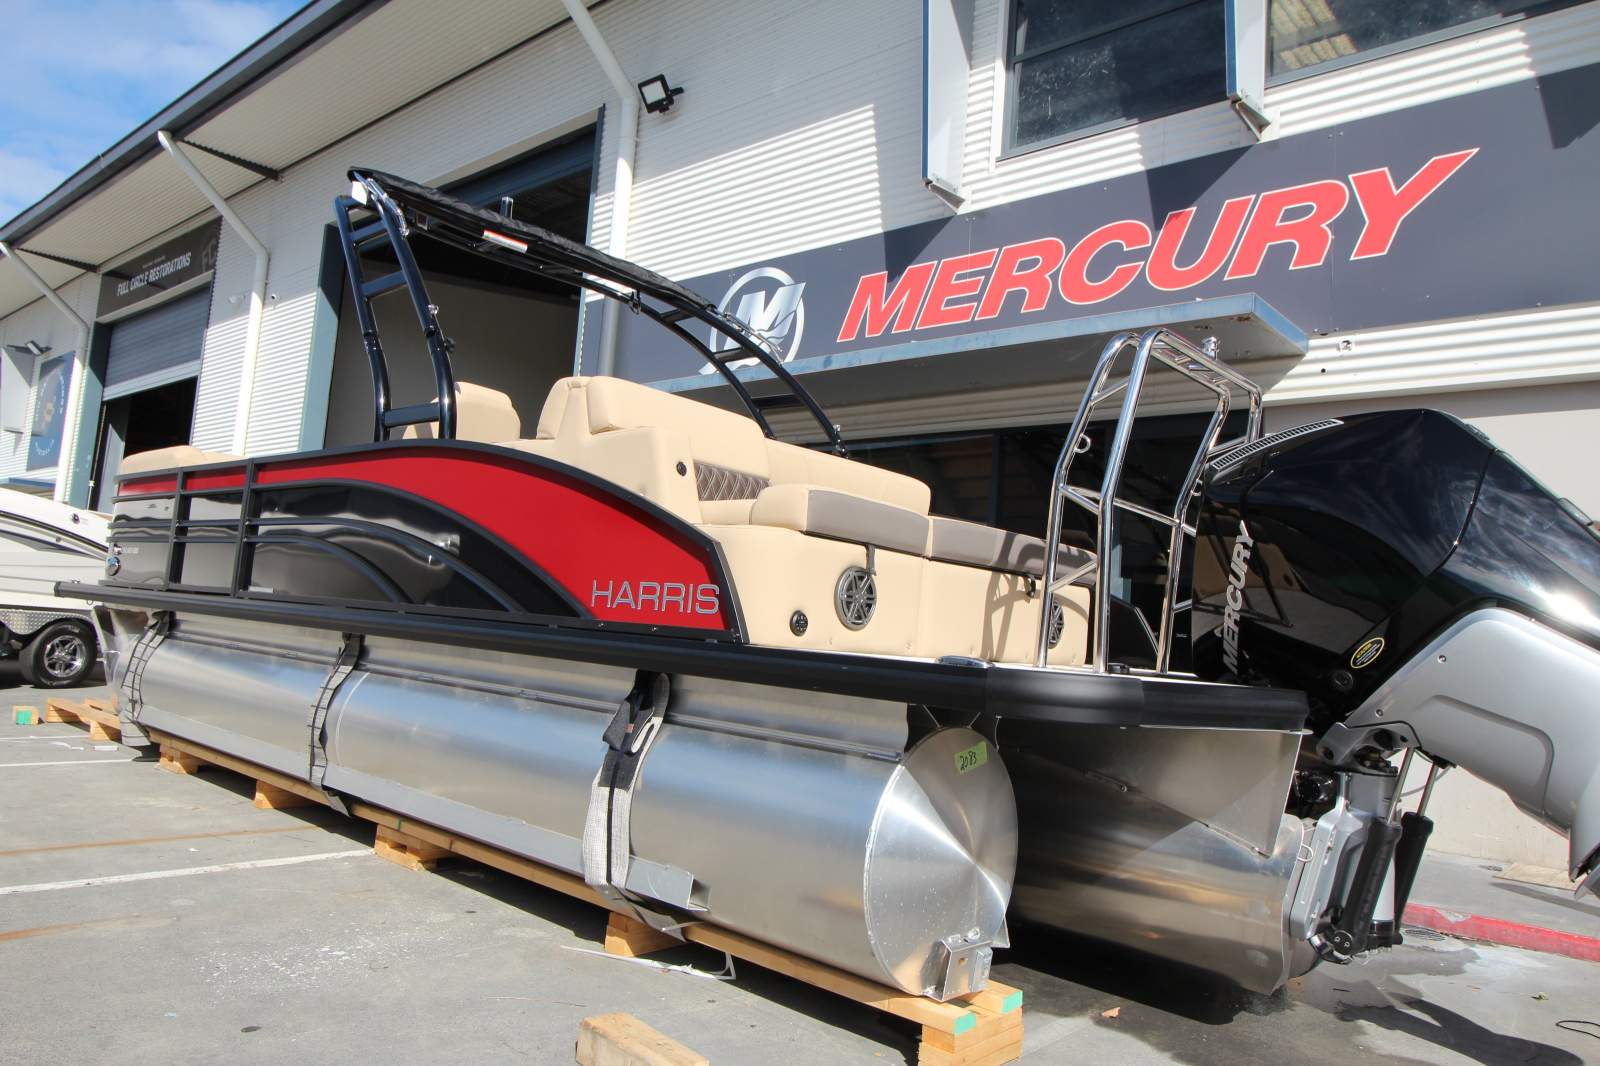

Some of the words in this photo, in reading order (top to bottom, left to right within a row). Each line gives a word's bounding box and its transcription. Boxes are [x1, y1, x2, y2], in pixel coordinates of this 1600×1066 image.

[117, 280, 129, 297] FULL
[130, 270, 149, 291] CIRCLE
[149, 252, 192, 282] RESTORATIONS
[837, 147, 1480, 343] MERCURY
[591, 580, 720, 615] HARRIS
[1223, 520, 1254, 675] MERCURY
